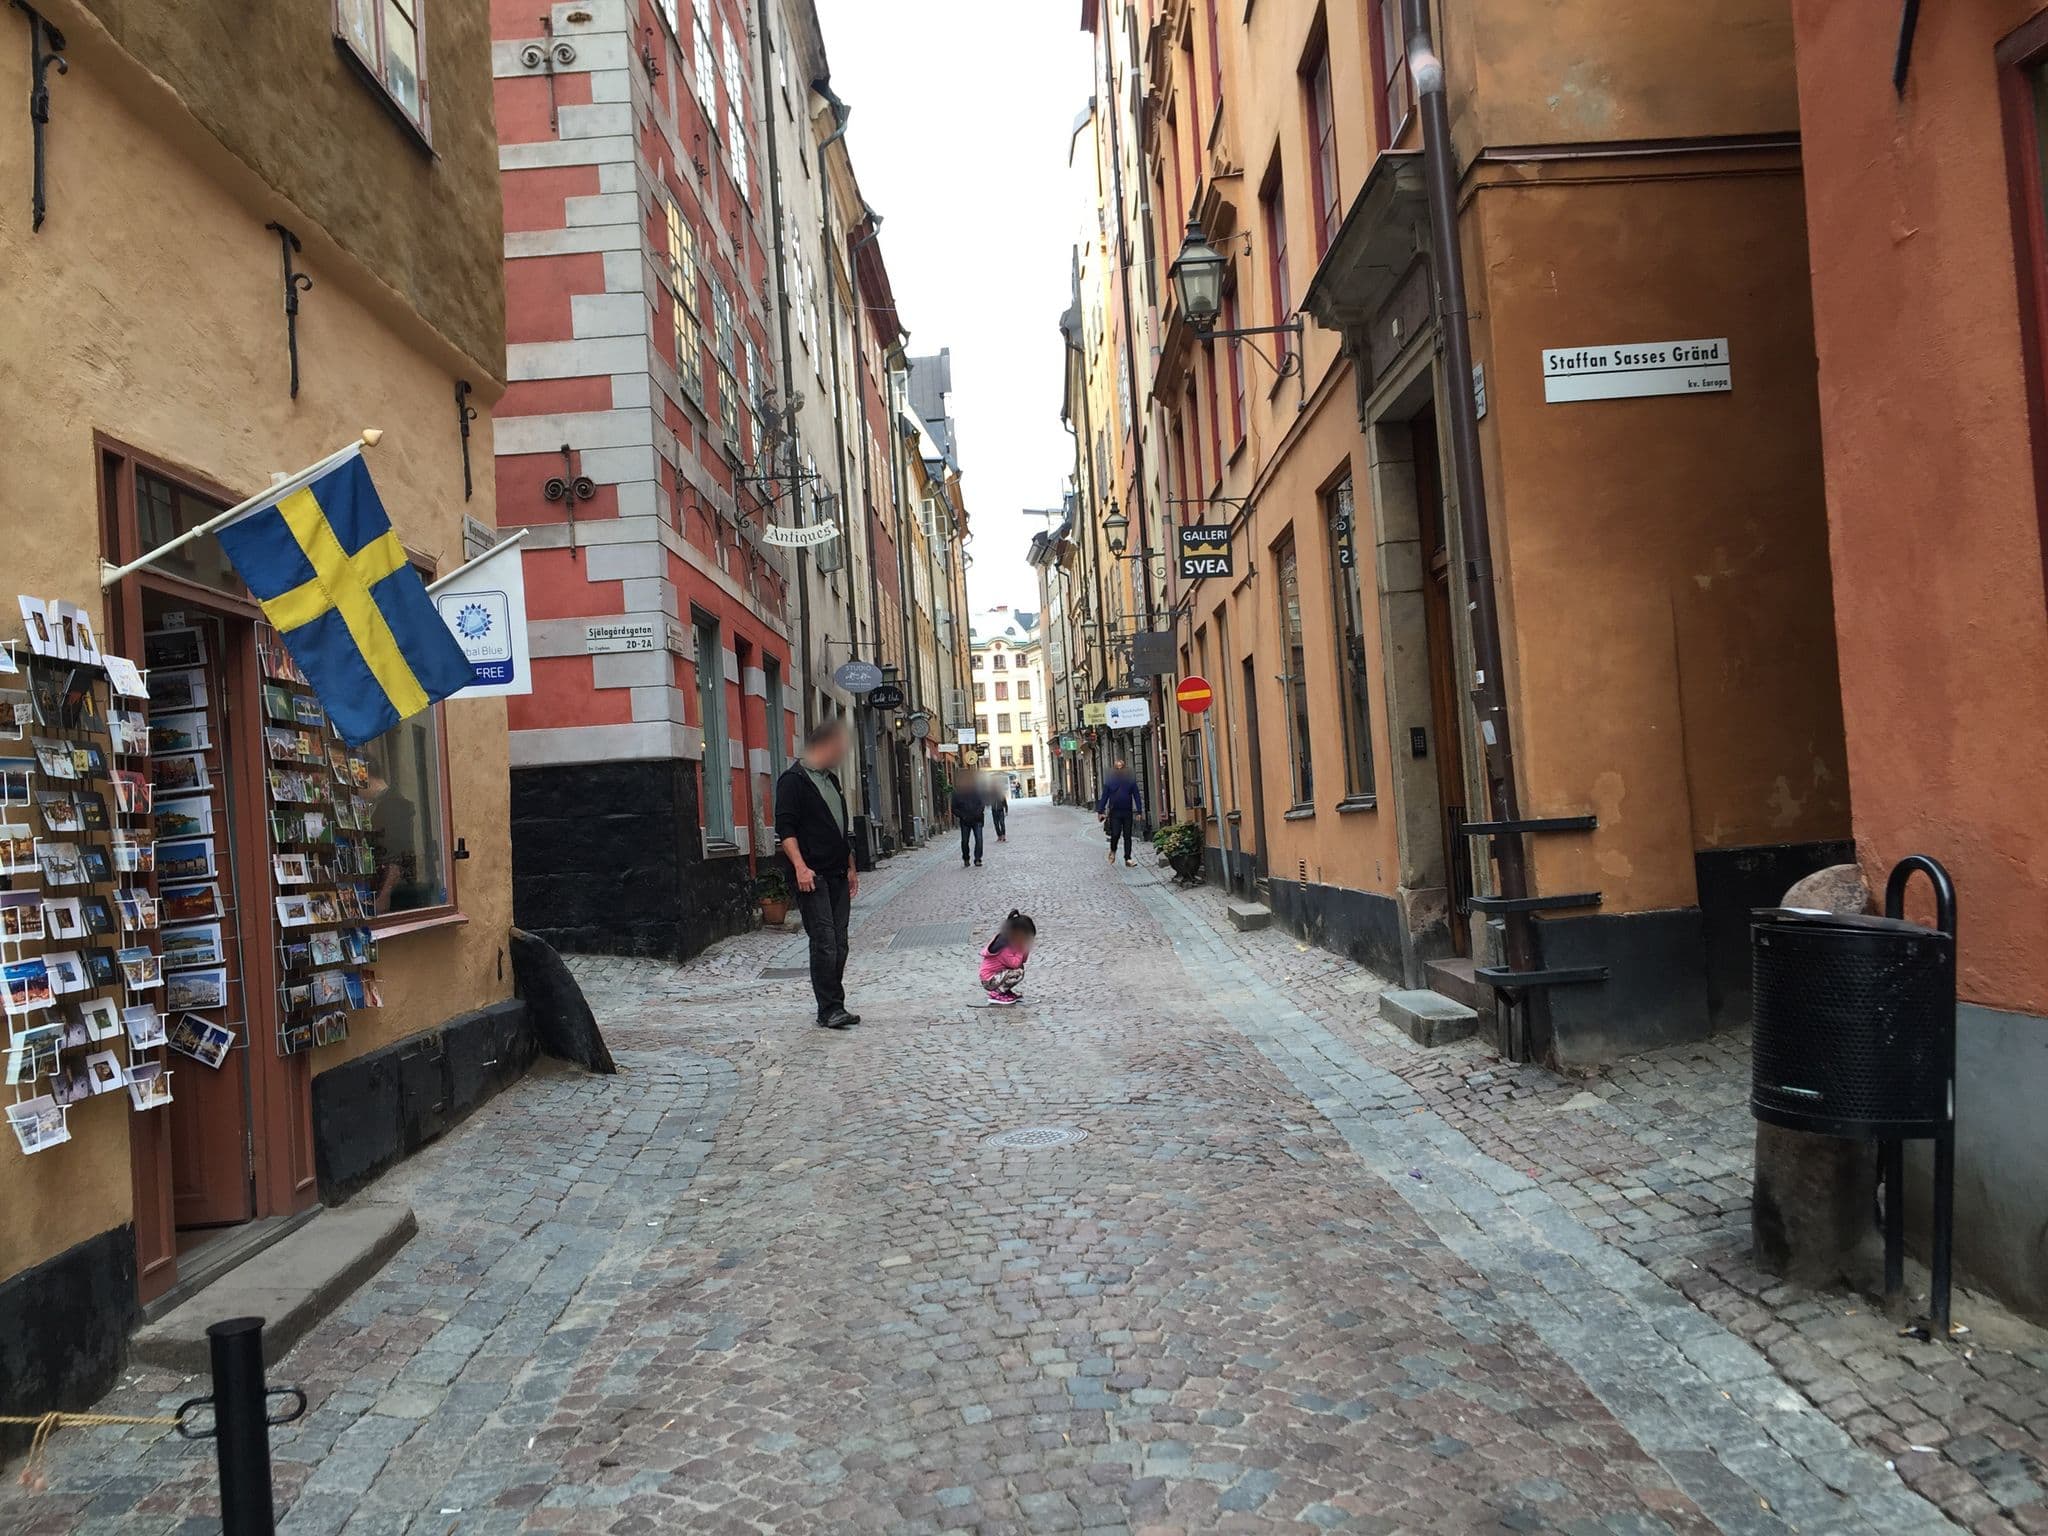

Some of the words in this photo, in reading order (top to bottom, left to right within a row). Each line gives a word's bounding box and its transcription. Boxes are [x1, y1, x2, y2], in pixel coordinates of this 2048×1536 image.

[1550, 352, 1607, 370] Staffan
[1614, 351, 1666, 366] Sasses
[1672, 344, 1719, 362] Gränd
[1702, 378, 1728, 388] Europa
[768, 526, 832, 544] Antiques
[1183, 530, 1227, 541] GALLERI
[1185, 559, 1229, 574] SVEA
[482, 646, 503, 656] Blue
